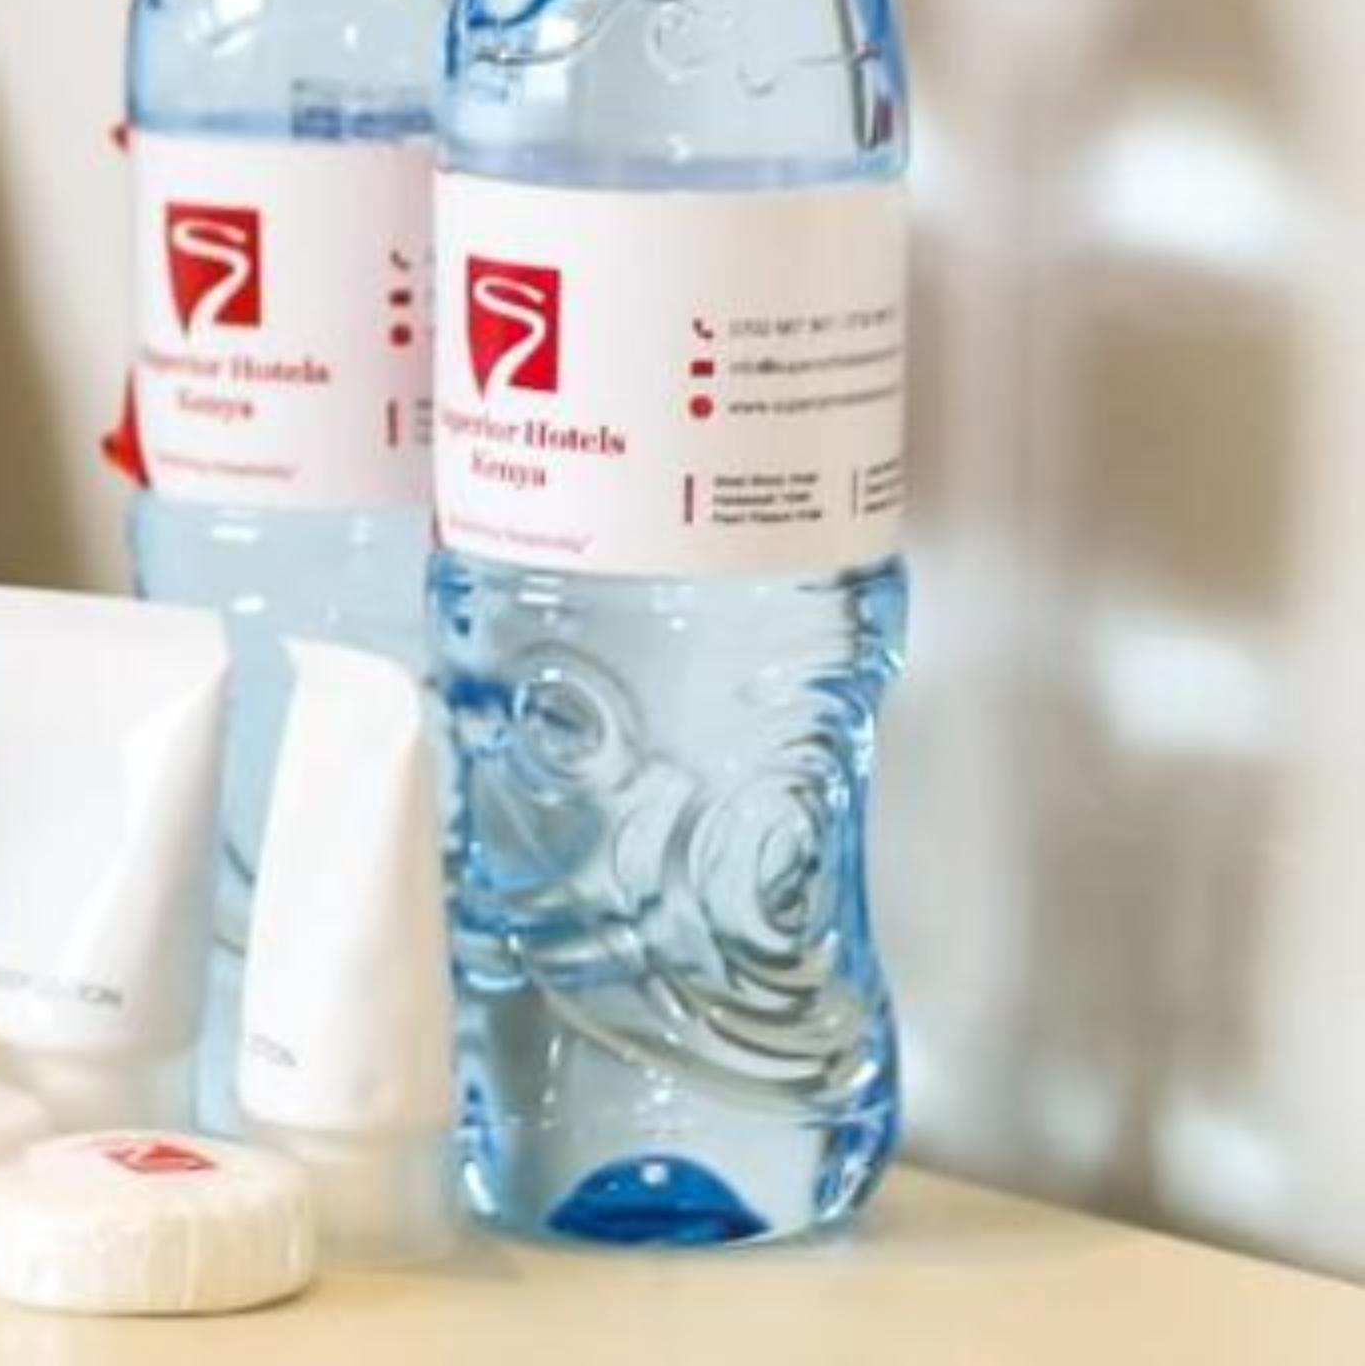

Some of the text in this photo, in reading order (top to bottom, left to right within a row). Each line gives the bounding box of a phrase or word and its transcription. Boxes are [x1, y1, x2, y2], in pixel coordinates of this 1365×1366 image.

[232, 355, 331, 384] Hotels
[179, 389, 254, 425] Kenya
[439, 407, 520, 439] uperior
[525, 419, 627, 455] Hotels
[471, 448, 547, 488] Kenya
